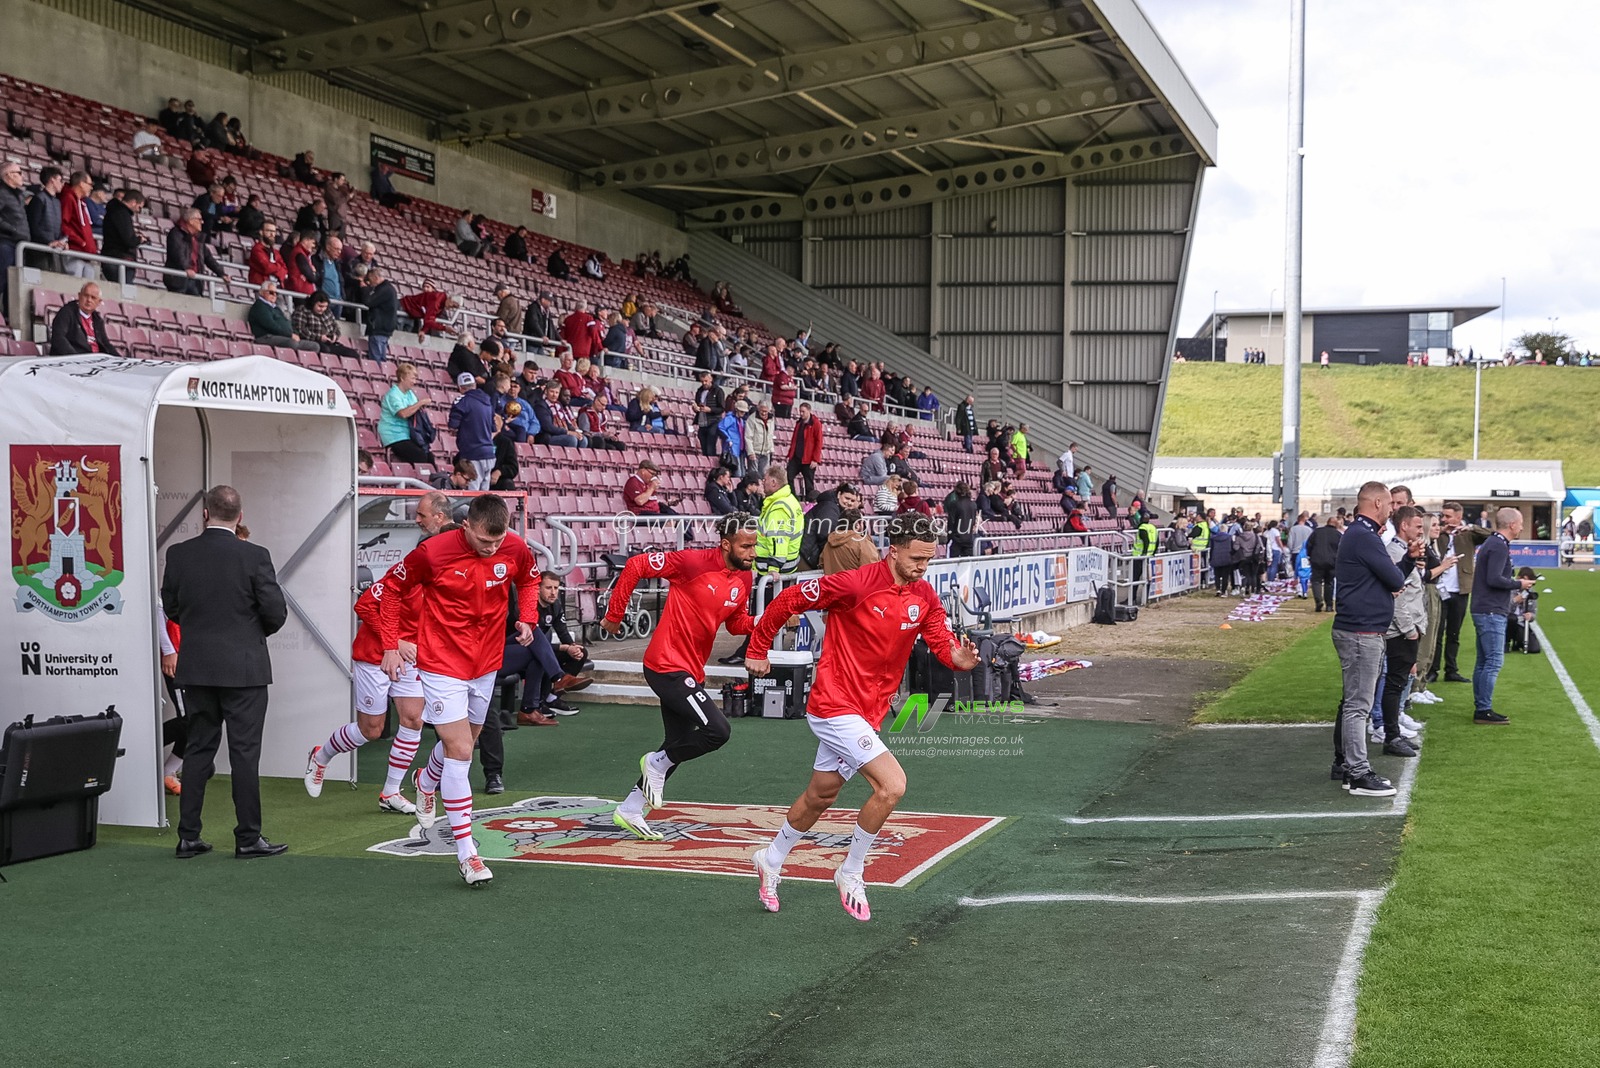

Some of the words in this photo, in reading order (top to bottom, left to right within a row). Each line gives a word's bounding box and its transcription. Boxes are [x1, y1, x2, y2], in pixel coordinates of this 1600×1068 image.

[201, 380, 290, 403] NORTHAMPTON
[292, 388, 324, 405] TOWN
[357, 549, 402, 563] ANTHER
[1168, 558, 1186, 588] TYRES
[973, 562, 1041, 612] CAMBELTS
[27, 590, 79, 619] NORTHAMPTON
[79, 602, 99, 616] TOWN
[99, 592, 112, 604] F.C.
[45, 653, 99, 666] University
[101, 653, 113, 664] of
[45, 665, 119, 678] Northampton
[754, 678, 777, 688] SOCCER
